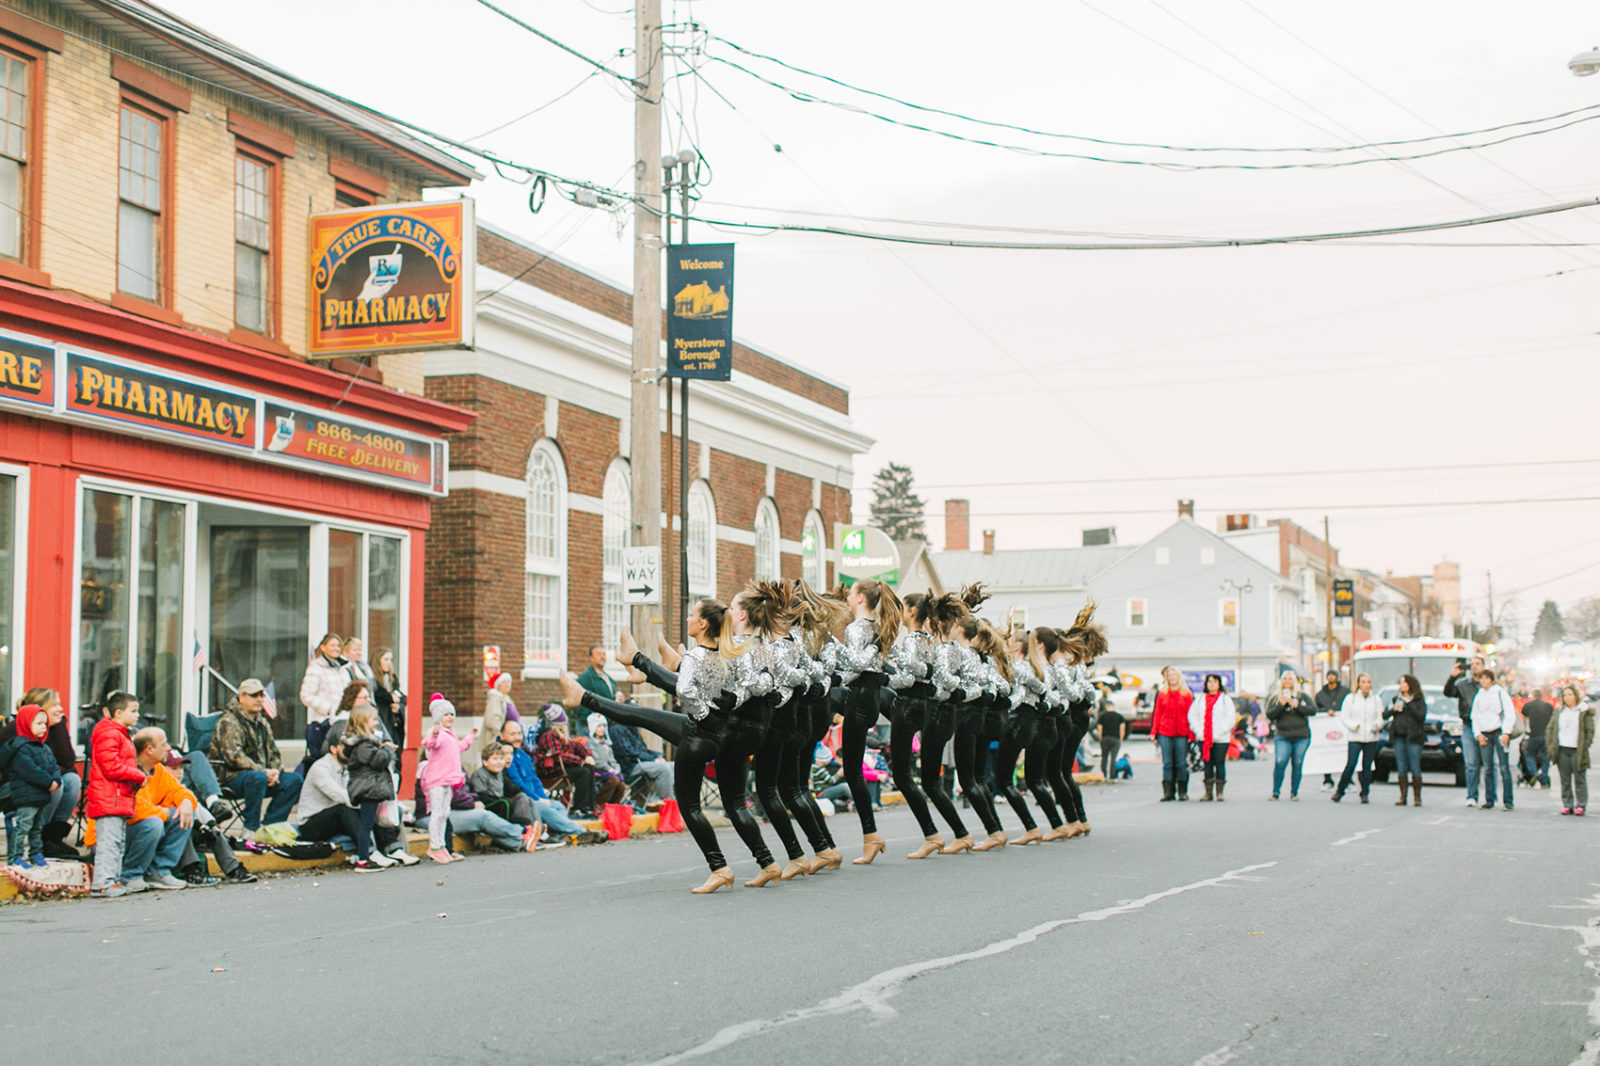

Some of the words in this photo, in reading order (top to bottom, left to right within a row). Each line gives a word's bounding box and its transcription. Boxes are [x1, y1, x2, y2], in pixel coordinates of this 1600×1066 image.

[330, 219, 381, 258] TRUE
[387, 218, 441, 250] CARE
[680, 258, 724, 270] Welcome
[323, 292, 450, 329] PHARMACY
[674, 338, 725, 350] Myerstown
[679, 348, 721, 361] Borough
[78, 365, 250, 436] PHARMACY
[306, 437, 347, 461] FREE
[350, 448, 420, 476] DELIVERY
[626, 567, 657, 581] WAY
